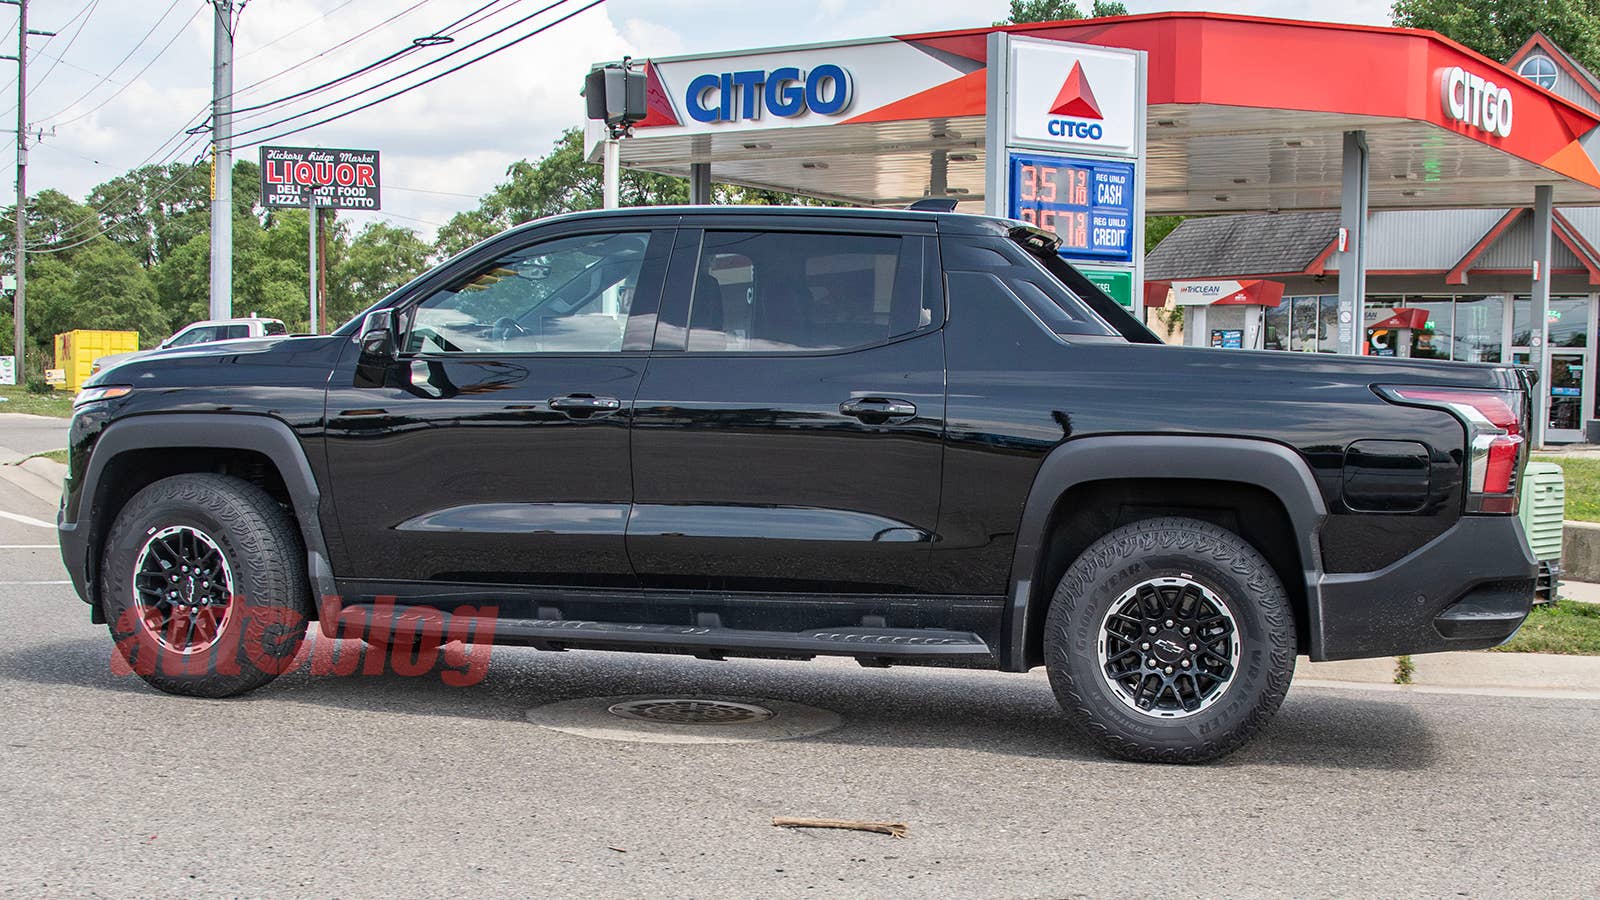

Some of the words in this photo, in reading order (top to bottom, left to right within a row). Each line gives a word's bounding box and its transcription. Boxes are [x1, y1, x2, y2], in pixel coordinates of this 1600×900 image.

[686, 64, 851, 123] CITGO
[1445, 66, 1512, 137] CITGO
[1048, 119, 1103, 140] CITGO
[267, 149, 303, 162] Hickory
[308, 151, 334, 163] Ridge
[339, 152, 375, 163] Market
[266, 160, 376, 188] LIQUOR
[1096, 173, 1108, 182] REG
[1109, 174, 1126, 184] UNLD
[277, 184, 301, 195] DELI
[338, 187, 366, 197] FOOD
[1098, 184, 1122, 205] CASH
[269, 195, 301, 205] PIZZA
[314, 196, 332, 206] TM
[340, 197, 374, 207] LOTTO
[1093, 217, 1107, 226] REG
[1108, 217, 1126, 227] UNLD
[1093, 227, 1126, 247] CREDIT
[1187, 285, 1220, 293] TriCLEAN
